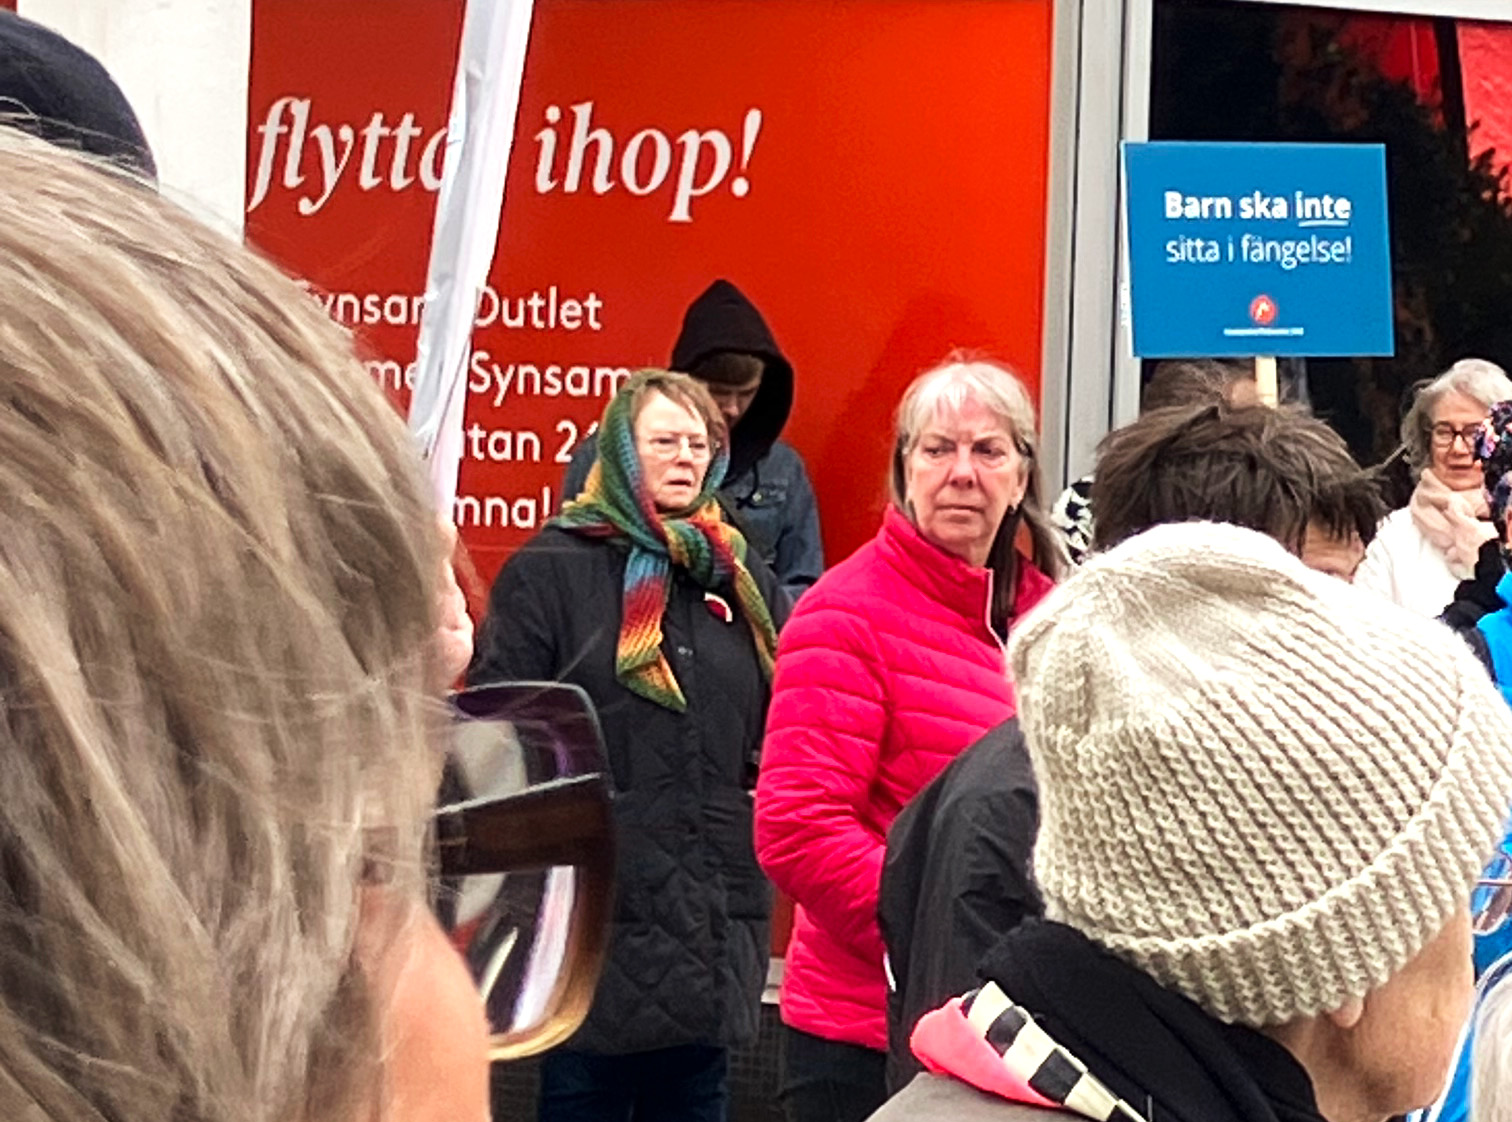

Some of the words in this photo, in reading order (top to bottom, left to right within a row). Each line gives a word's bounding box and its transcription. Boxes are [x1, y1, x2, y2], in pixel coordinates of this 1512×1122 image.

[534, 101, 762, 223] ihop!
[1164, 190, 1233, 220] Barn
[1239, 189, 1289, 220] ska
[1295, 190, 1352, 221] inte
[1166, 234, 1221, 264] sitta
[1227, 234, 1235, 263] i
[1241, 232, 1353, 271] fängelse!
